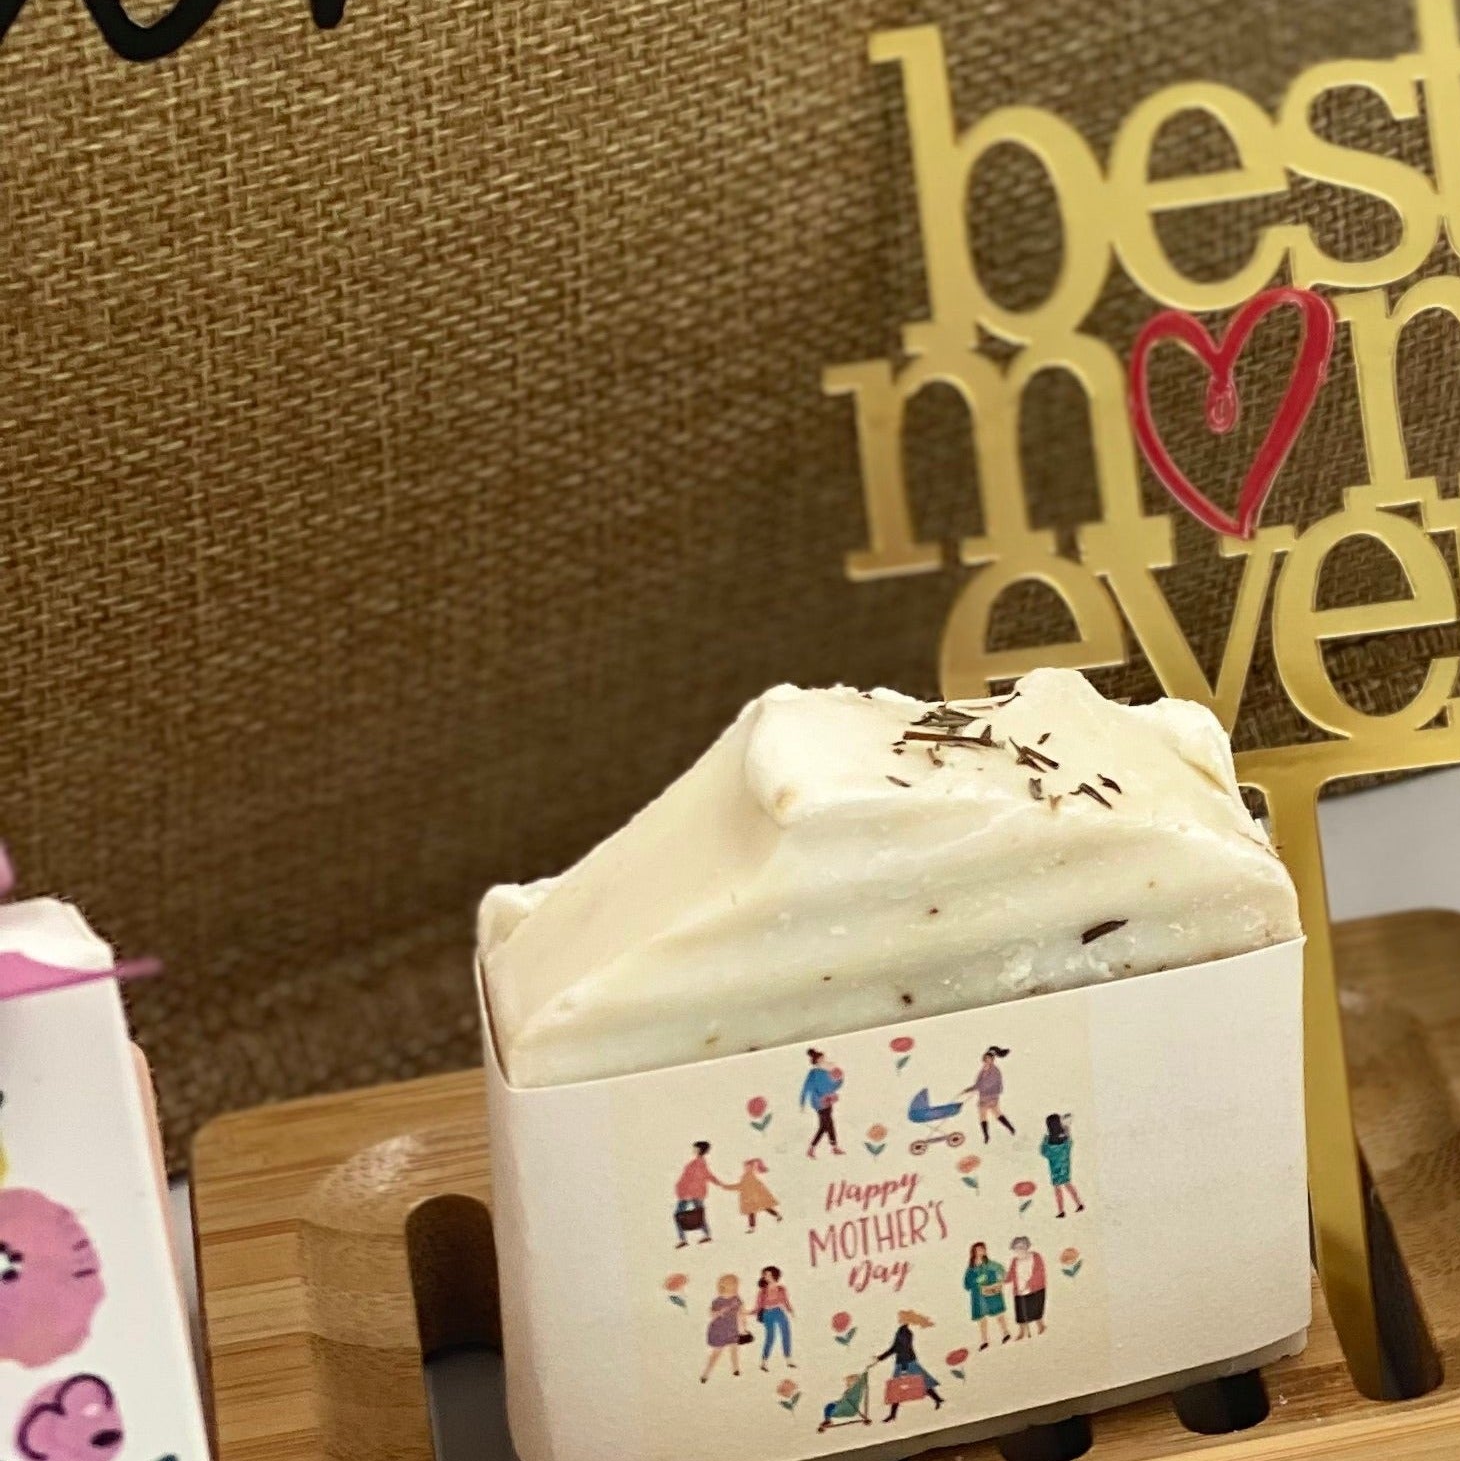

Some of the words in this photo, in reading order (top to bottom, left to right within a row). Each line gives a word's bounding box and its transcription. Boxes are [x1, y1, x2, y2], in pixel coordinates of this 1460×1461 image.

[824, 1172, 920, 1212] Happy
[807, 1199, 949, 1268] MOTHER'S
[847, 1259, 912, 1294] Day
